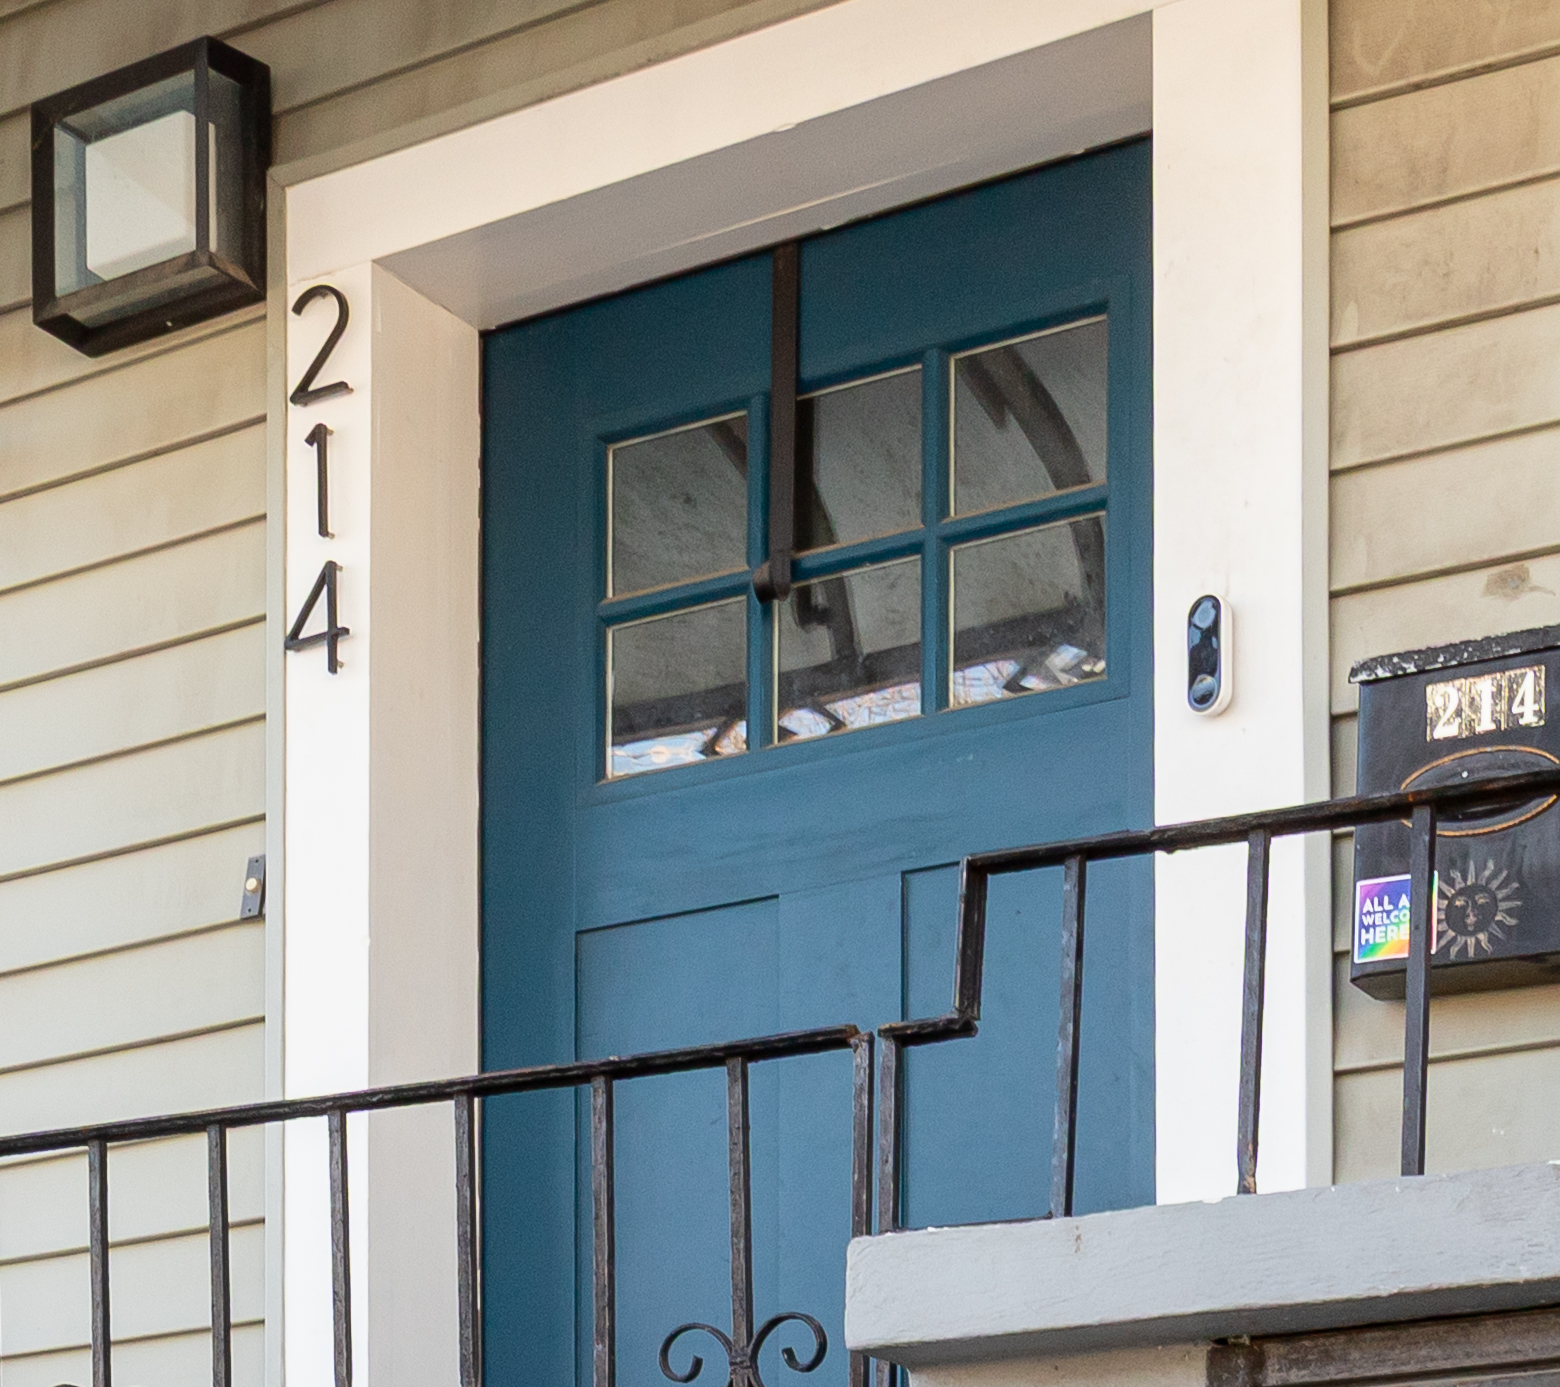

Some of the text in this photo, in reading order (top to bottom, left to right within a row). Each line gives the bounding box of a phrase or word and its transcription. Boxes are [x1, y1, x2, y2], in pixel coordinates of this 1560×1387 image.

[284, 284, 354, 675] 214
[1432, 670, 1540, 740] 214
[1362, 894, 1394, 914] ALL
[1361, 909, 1410, 926] WELCO
[1360, 923, 1410, 946] HERE
